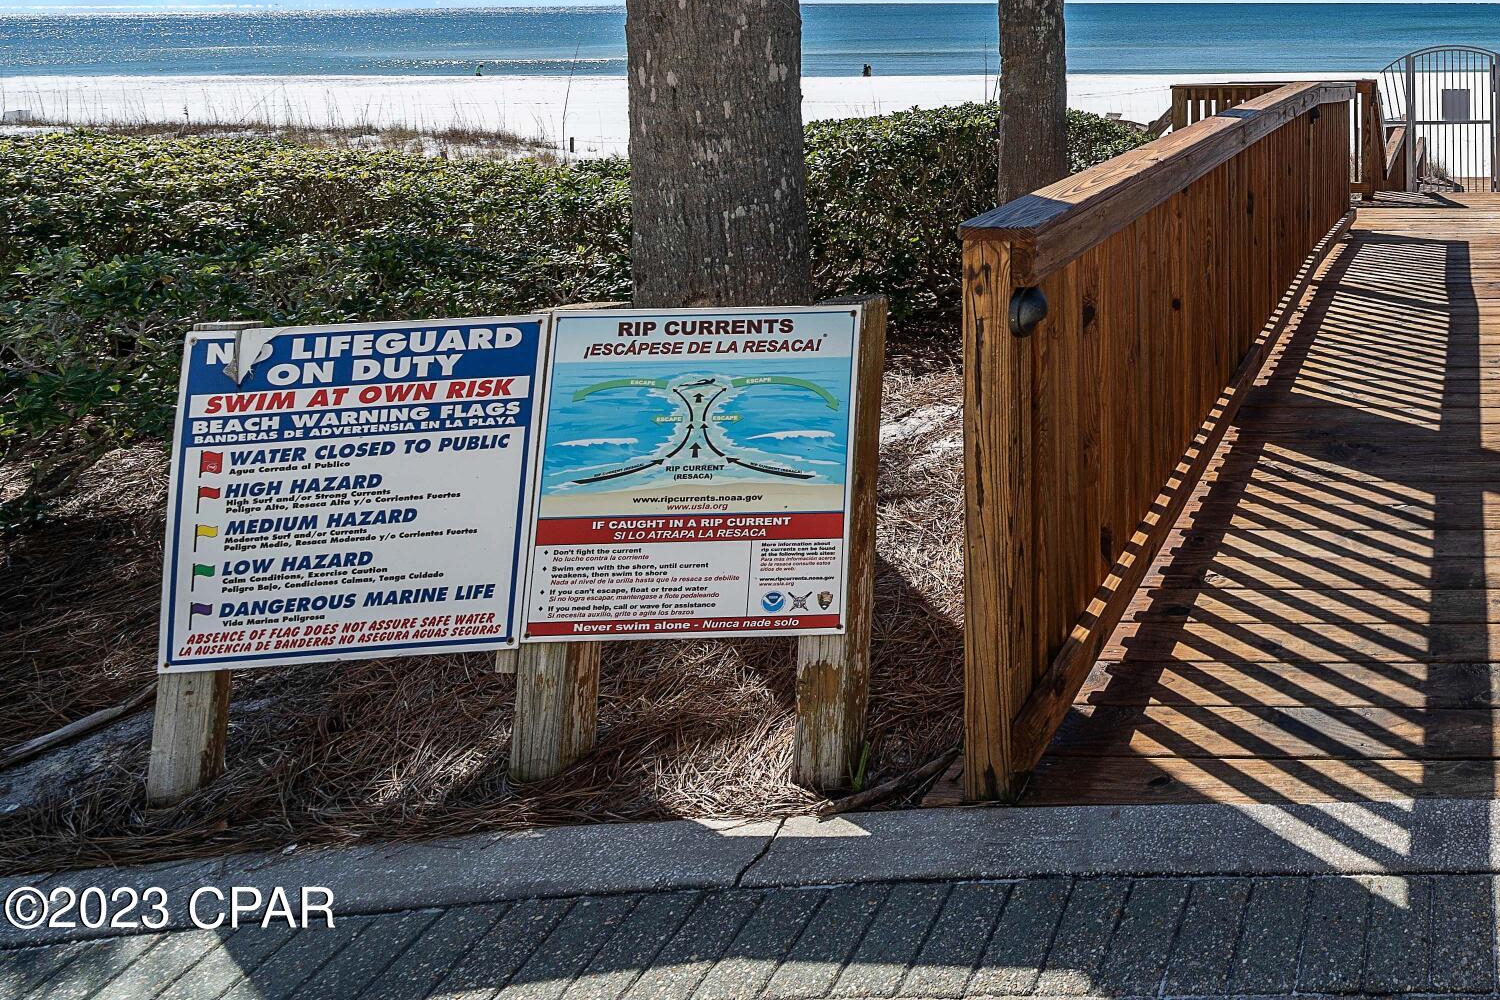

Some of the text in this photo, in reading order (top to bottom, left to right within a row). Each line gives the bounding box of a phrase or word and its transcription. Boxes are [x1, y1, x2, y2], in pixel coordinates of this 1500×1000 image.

[618, 318, 794, 336] RIP CURRENTS
[290, 326, 522, 360] LIFEGUARD
[583, 338, 822, 359] ¡ESCÁPESE DE LA RESACA!
[266, 353, 463, 386] ON DUTY
[204, 378, 515, 414] SWIM AT OWN RISK
[192, 401, 520, 434] BEACH WARNING FLAGS
[194, 416, 516, 444] BANDERAS DE ADVERTENSIA EN LA PLAYA
[230, 434, 510, 466] WATER CLOSED TO PUBLIC
[258, 464, 298, 472] Cerrada
[314, 460, 350, 468] Publico
[224, 474, 382, 498] HIGH HAZARD
[225, 504, 261, 514] Peligro
[264, 503, 288, 511] Alto,
[330, 498, 350, 506] Alta
[353, 496, 372, 506] y/o
[374, 494, 424, 502] Corrientes
[226, 498, 249, 506] High
[252, 496, 273, 504] Surf
[276, 494, 312, 502] and/or
[350, 488, 390, 497] Currents
[632, 494, 762, 504] www.ripcurrents.noaa.gov
[666, 502, 728, 510] www.usla.org
[224, 508, 417, 536] MEDIUM HAZARD
[592, 516, 791, 529] IF CAUGHT IN A RIP CURRENT
[224, 528, 367, 544] Moderate Surf and/or Currents
[224, 543, 256, 552] Peligro
[260, 540, 292, 548] Medio,
[330, 534, 376, 543] Moderado
[379, 532, 396, 542] y/o
[398, 530, 443, 538] Corrientes
[613, 528, 766, 540] SI LO ATRAPA LA RESACA
[222, 550, 373, 576] LOW HAZARD
[221, 585, 254, 594] Peligro
[257, 582, 281, 591] Bajo,
[284, 579, 338, 588] Condiciones
[408, 570, 444, 579] Cuidado
[249, 573, 304, 582] Conditions,
[308, 569, 348, 578] Exercise
[351, 566, 388, 574] Caution
[218, 583, 496, 618] DANGEROUS MARINE LIFE
[548, 606, 554, 614] If
[186, 612, 495, 644] ABSENCE OF FLAG DOES NOT ASSURE SAFE WATER
[246, 617, 279, 625] Marina
[282, 614, 325, 623] Peligrosa
[573, 618, 799, 632] Never swim alone Nunca nade solo
[178, 624, 501, 656] LA AUSENCIA DE BANDERAS NO ASEGURA AGUAS SEGURAS
